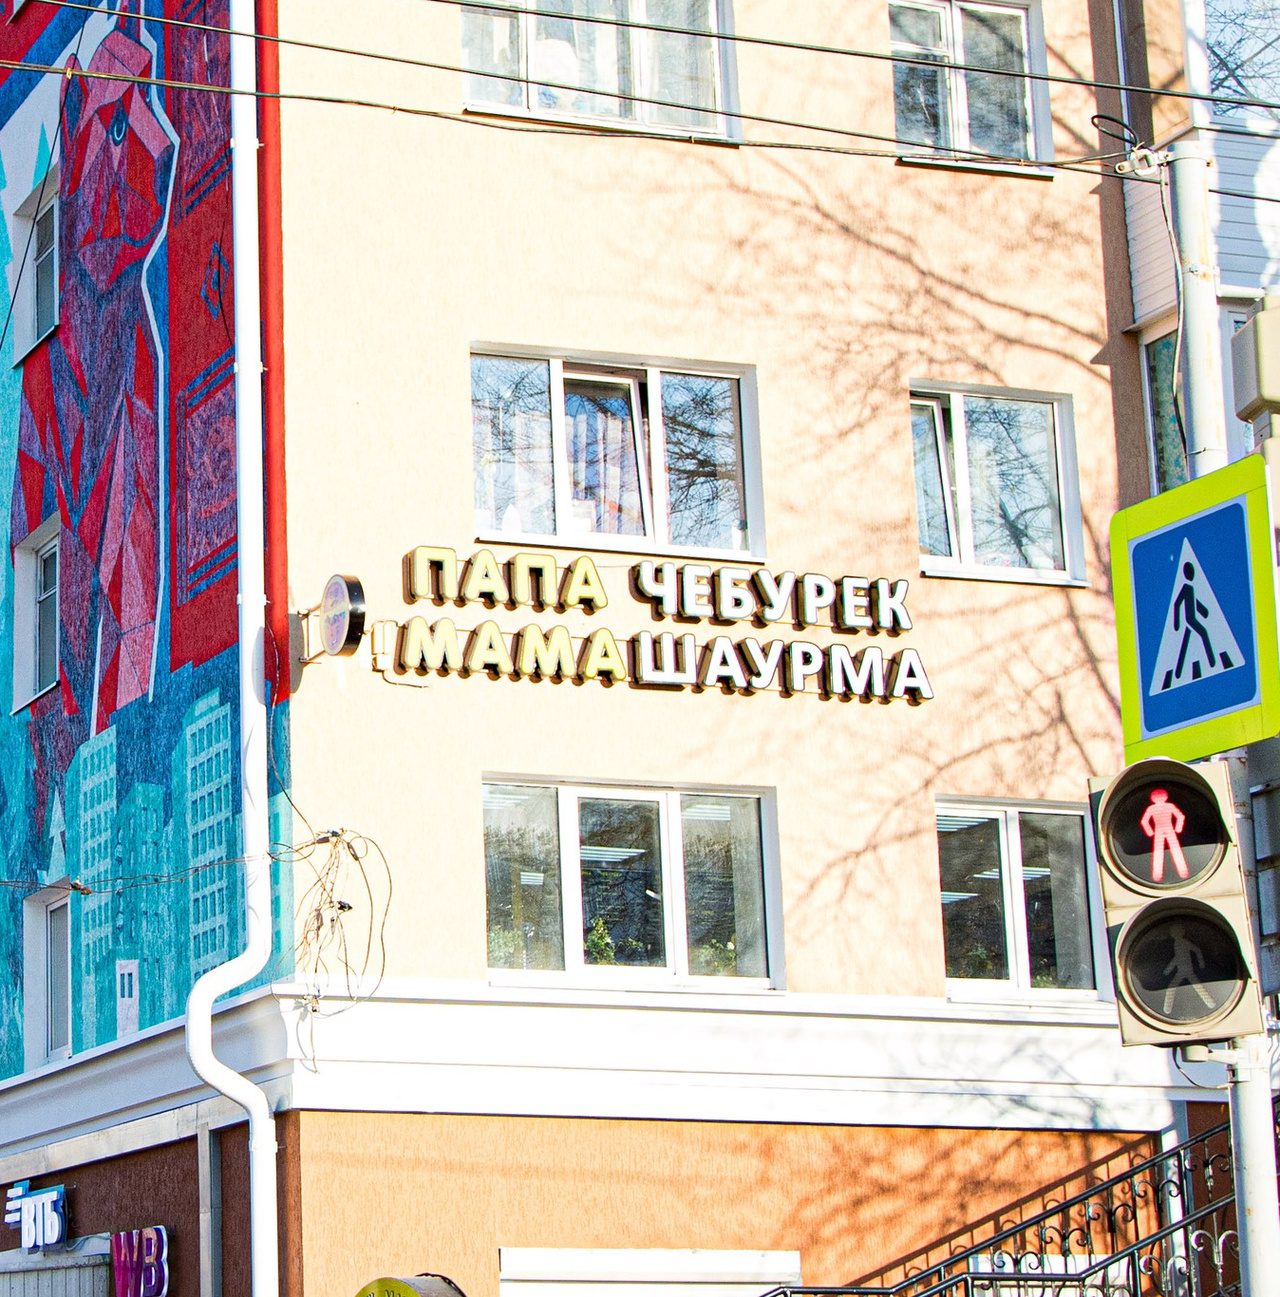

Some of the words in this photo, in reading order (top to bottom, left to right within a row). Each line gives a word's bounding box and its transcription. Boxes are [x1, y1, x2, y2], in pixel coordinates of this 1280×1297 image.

[408, 545, 608, 613] ПАПА
[634, 560, 914, 632] ЧЕБУРЕК
[404, 615, 627, 682] МАМА
[636, 630, 935, 701] ШАУРМА
[21, 1190, 60, 1249] ВТБ
